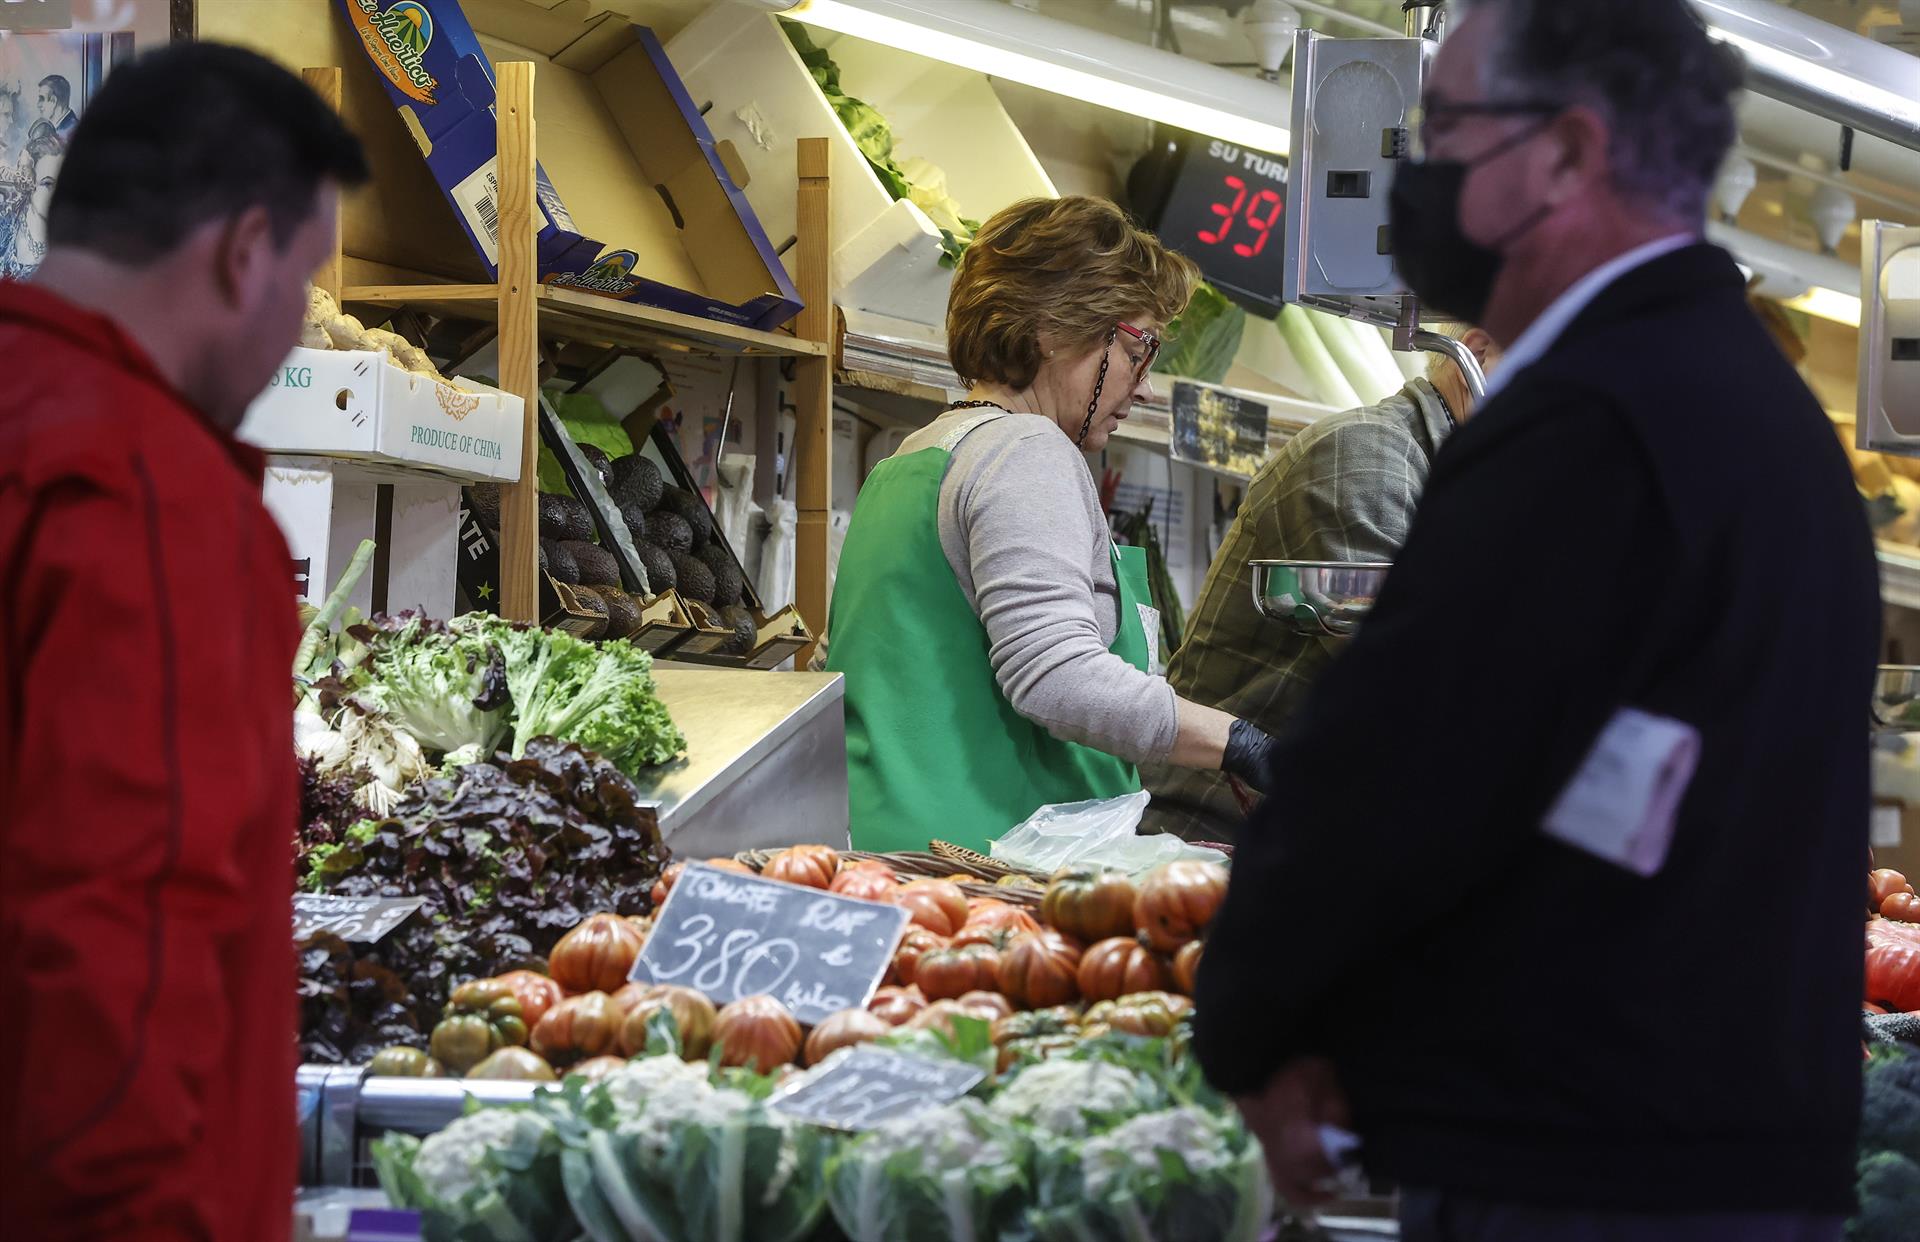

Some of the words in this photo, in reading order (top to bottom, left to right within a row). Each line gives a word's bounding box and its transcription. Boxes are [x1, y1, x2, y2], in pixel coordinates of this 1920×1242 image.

[369, 11, 433, 88] Huertico
[1208, 140, 1239, 163] SU
[1243, 152, 1288, 184] TUR
[1197, 175, 1283, 258] 39
[284, 366, 312, 388] KG
[411, 425, 457, 452] PRODUCE
[459, 435, 472, 453] OF
[474, 438, 502, 461] CHINA
[687, 868, 791, 914] TOMATE
[799, 898, 879, 937] RAF
